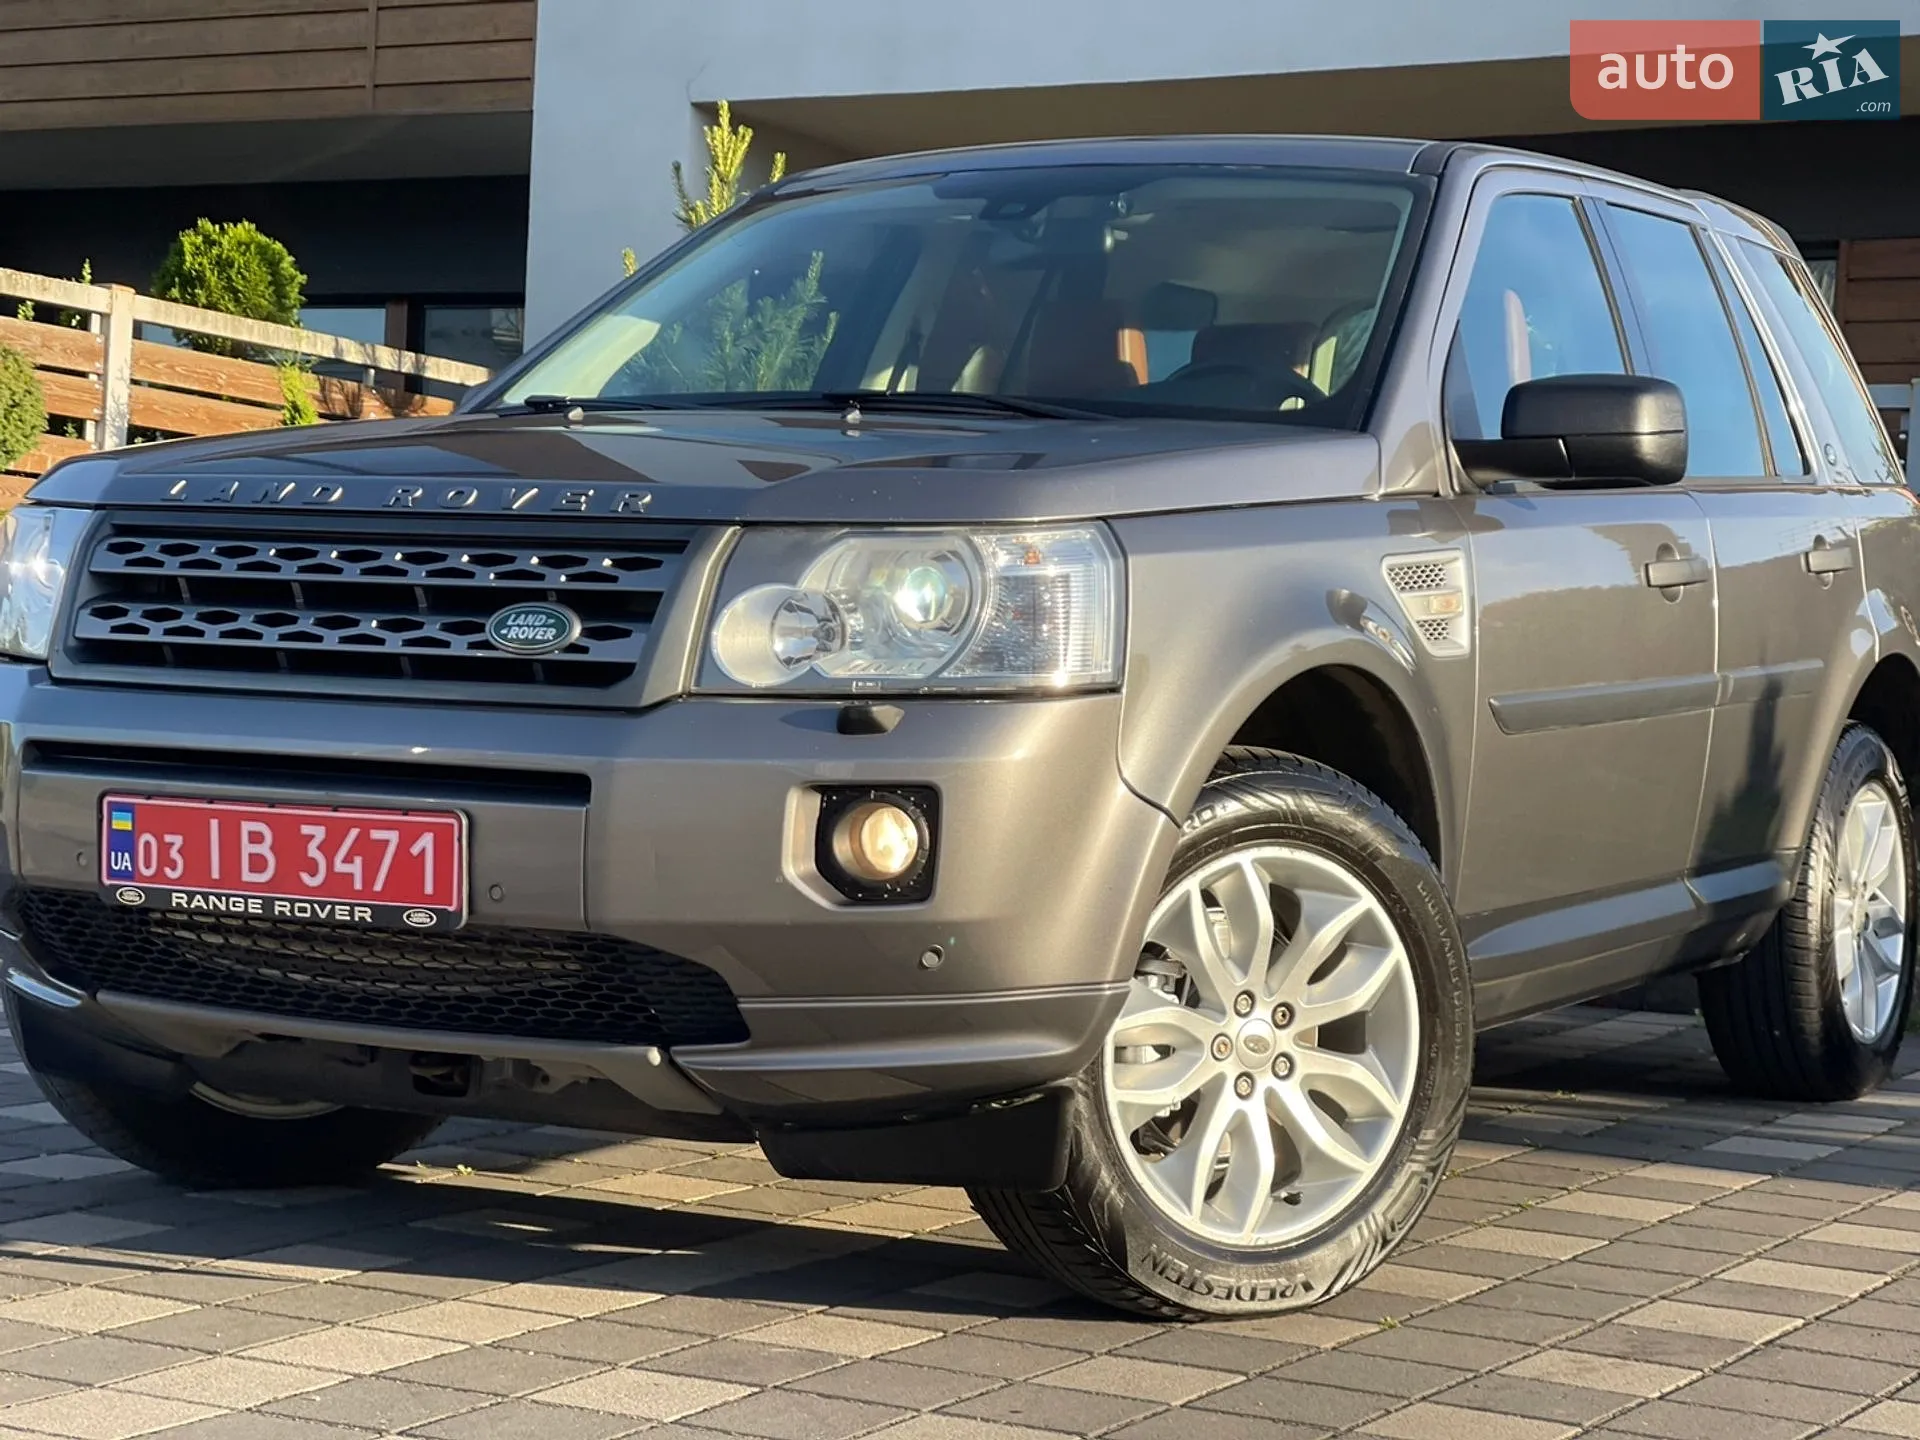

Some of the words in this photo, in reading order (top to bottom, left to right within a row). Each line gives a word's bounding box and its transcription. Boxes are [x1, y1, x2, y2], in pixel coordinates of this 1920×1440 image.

[160, 479, 343, 504] LAND
[382, 486, 653, 514] ROVER
[506, 614, 547, 626] LAND
[507, 626, 557, 640] ROVER
[110, 851, 132, 871] UA
[137, 832, 184, 880] 03
[209, 818, 276, 883] IB
[299, 824, 434, 895] 3471
[171, 892, 263, 914] RANGE
[274, 901, 373, 922] ROVER
[1141, 1243, 1315, 1302] VREDESTEIN
